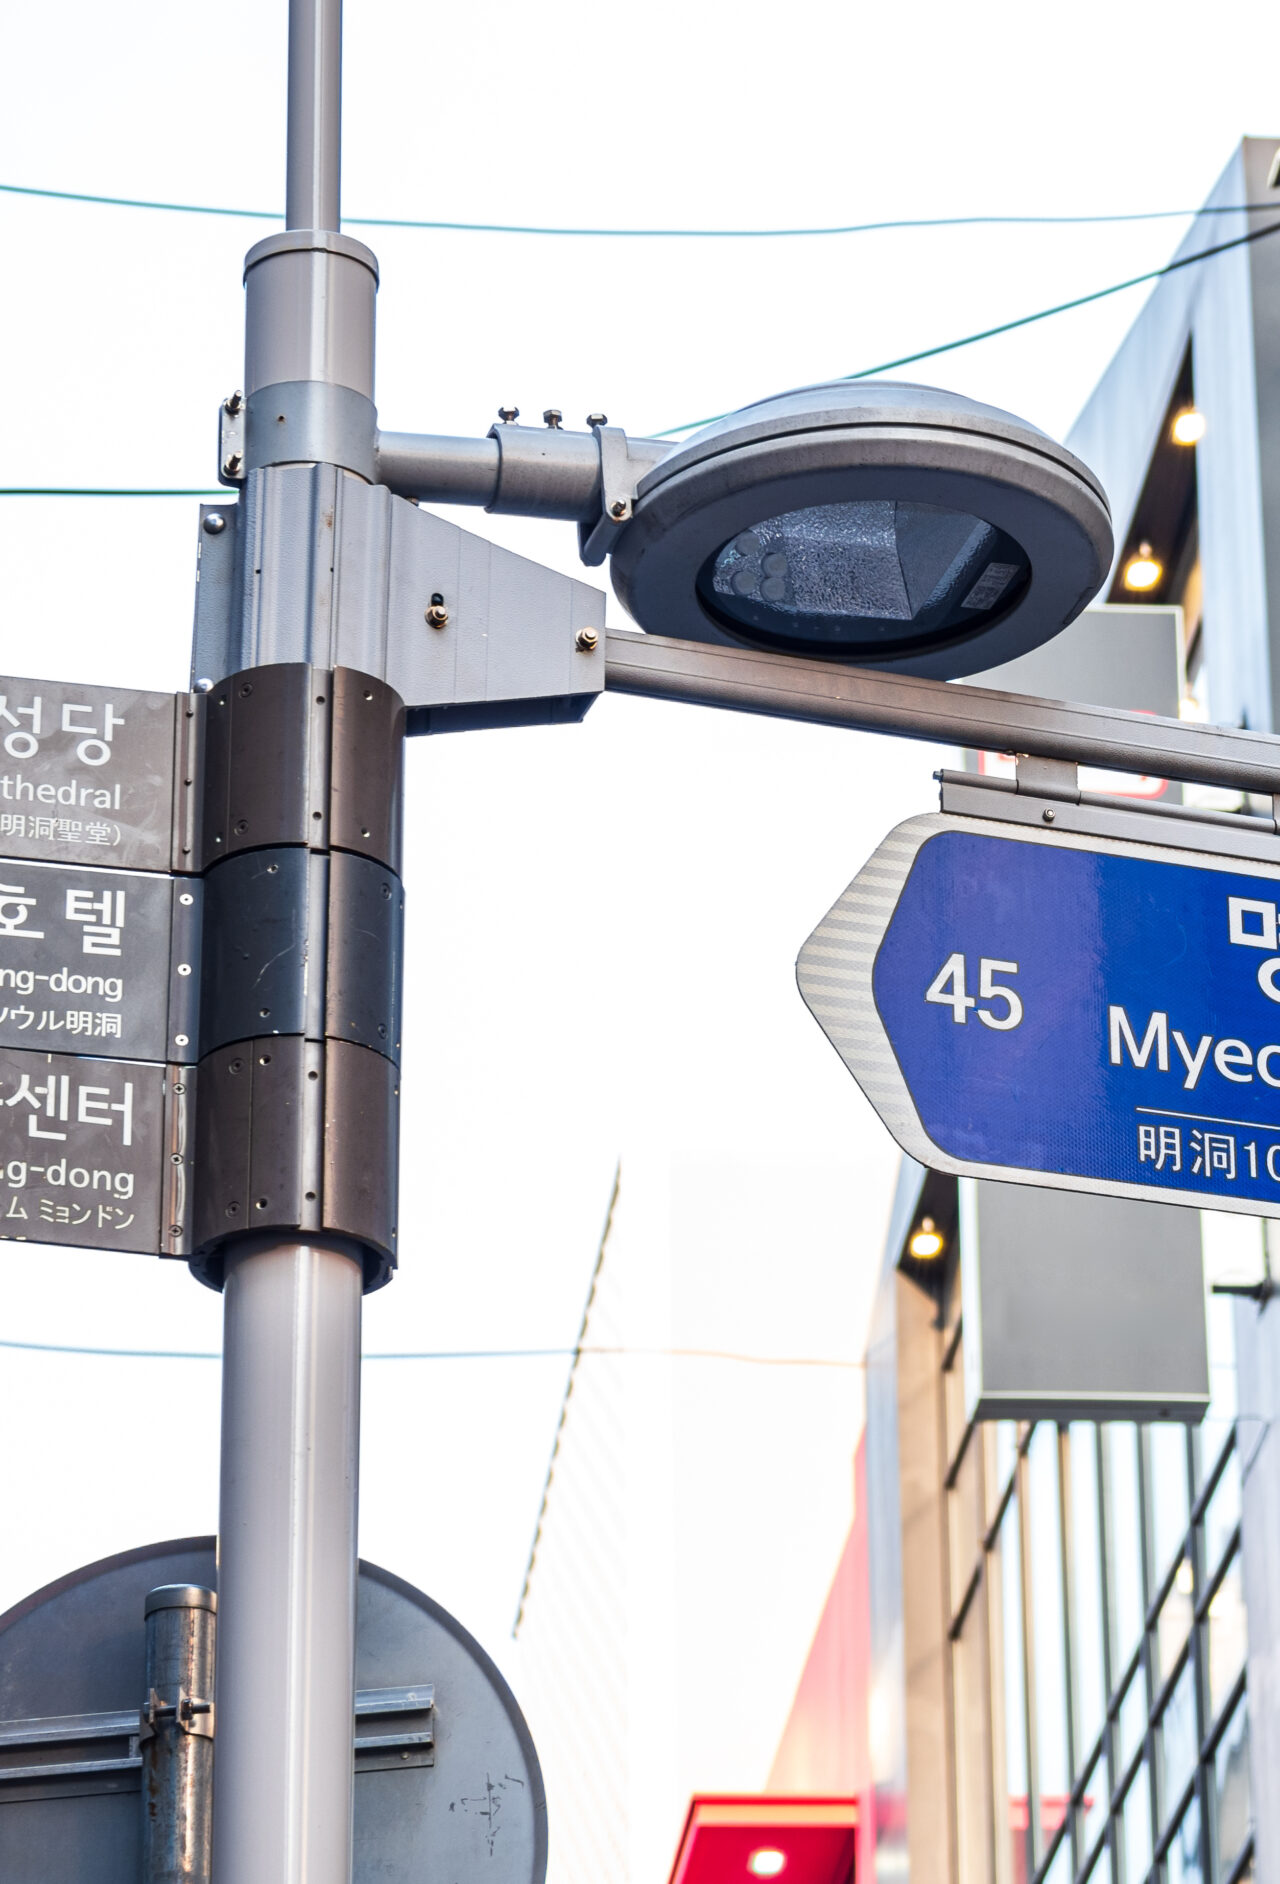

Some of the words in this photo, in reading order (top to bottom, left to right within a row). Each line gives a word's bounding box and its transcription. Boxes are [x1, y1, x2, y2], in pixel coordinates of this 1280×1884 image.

[926, 953, 1023, 1030] 45
[0, 1073, 133, 1146] 센터
[0, 1158, 134, 1199] g-dong
